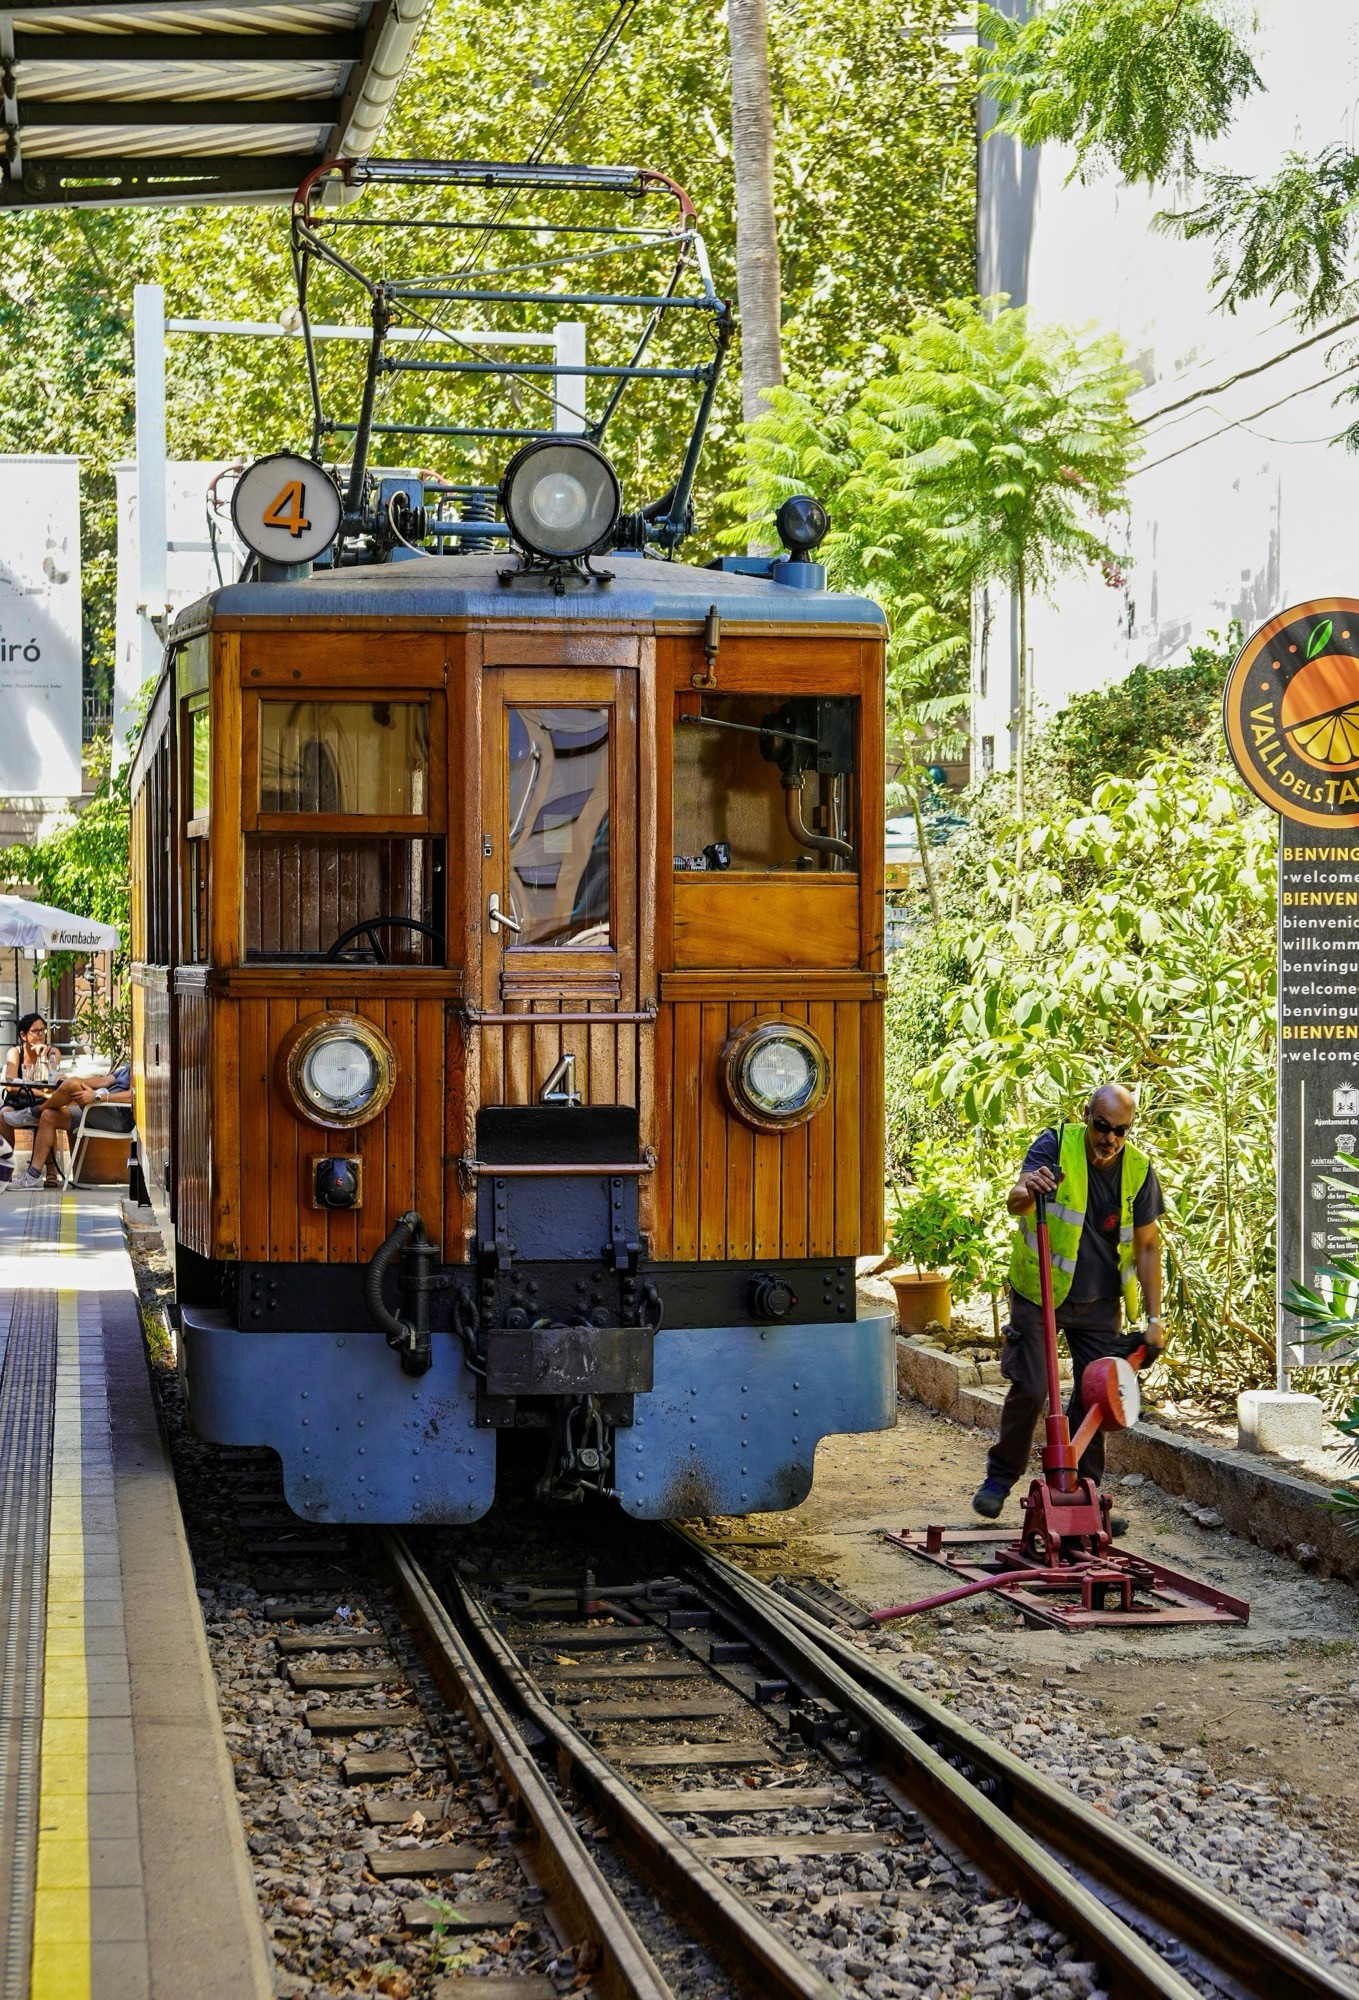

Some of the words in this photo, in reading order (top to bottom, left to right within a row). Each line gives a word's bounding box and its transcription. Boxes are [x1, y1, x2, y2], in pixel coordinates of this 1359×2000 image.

[263, 480, 311, 538] 4
[1250, 702, 1287, 776] VALL
[1279, 769, 1324, 803] DELS
[1324, 776, 1359, 806] TA
[1283, 847, 1359, 862] BENVING
[1283, 892, 1358, 906] BIENVEN
[59, 930, 101, 945] Krombacher
[1283, 937, 1359, 950] willkomm
[1283, 959, 1358, 975] benvingu
[1283, 1003, 1358, 1019] benvingu
[1283, 1025, 1358, 1039] BIENVEN
[539, 1054, 582, 1107] 4
[1314, 1118, 1350, 1127] Ajuntament
